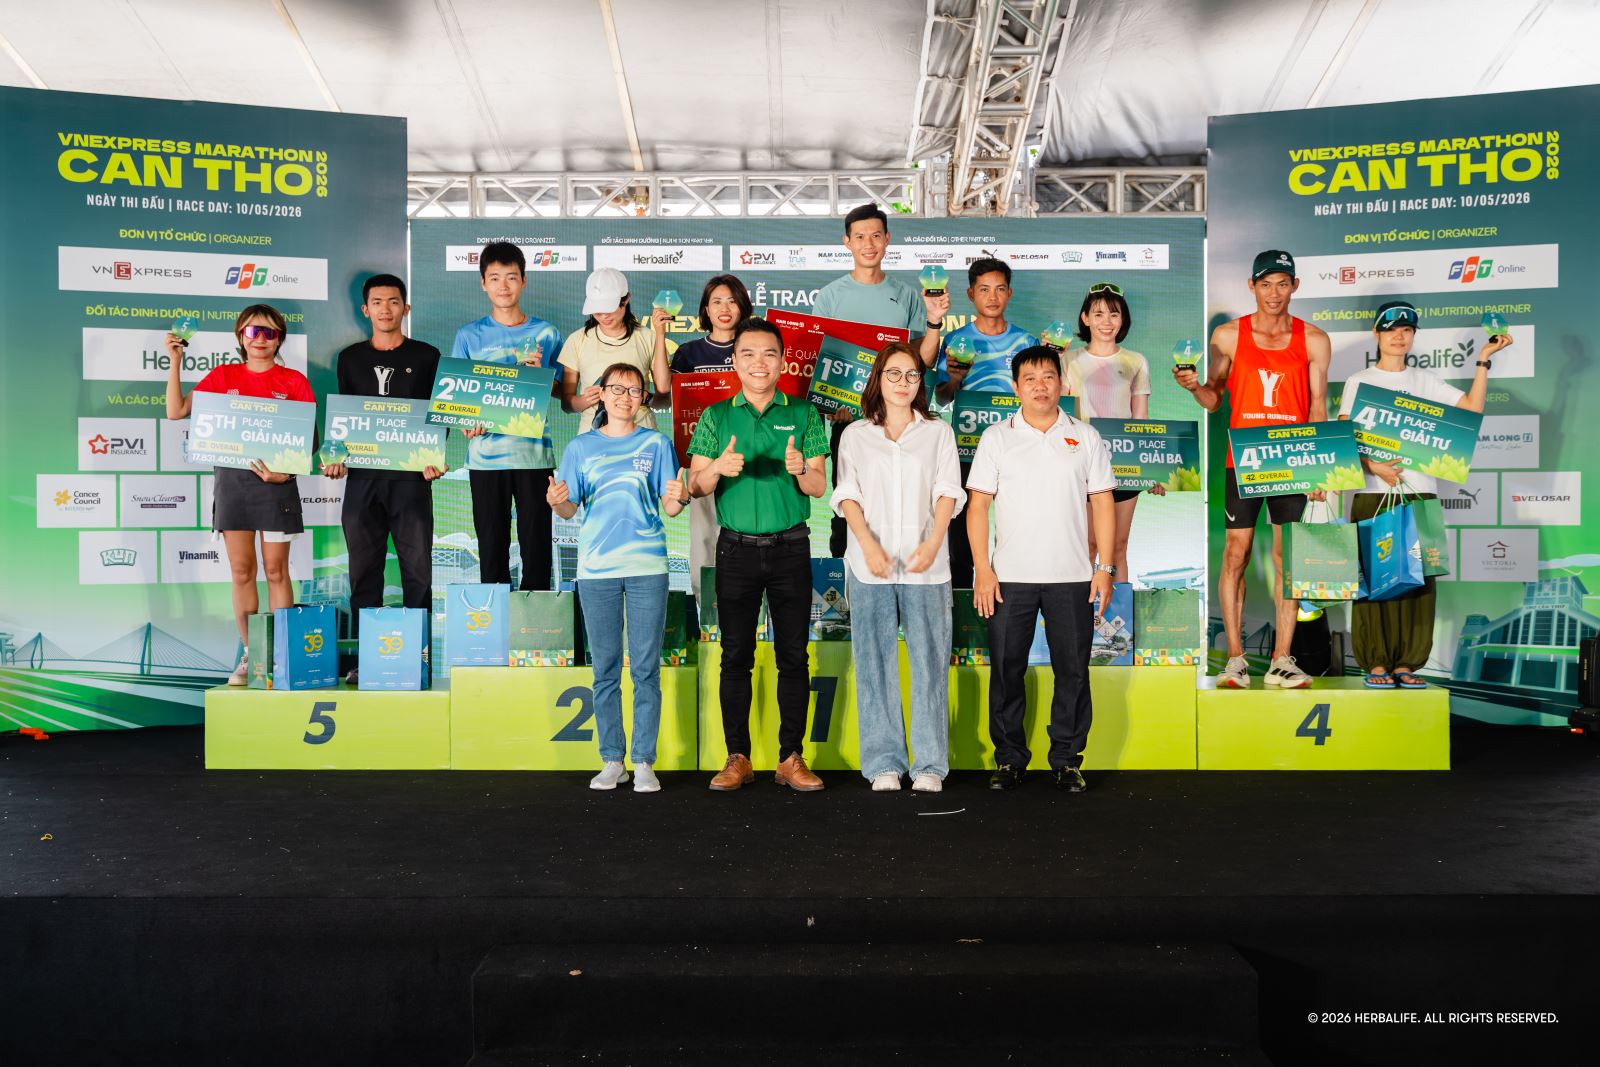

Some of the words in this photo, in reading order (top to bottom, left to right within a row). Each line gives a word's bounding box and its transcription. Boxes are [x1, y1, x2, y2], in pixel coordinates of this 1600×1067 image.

[57, 132, 191, 154] VNEXPRESS
[195, 142, 313, 162] MARATHON
[1289, 141, 1416, 162] VNEXPRESS
[1419, 132, 1543, 153] MARATHON
[1546, 131, 1559, 180] 2026
[57, 149, 182, 188] CAN
[193, 158, 313, 196] THO
[316, 150, 328, 198] 2026
[1288, 158, 1406, 196] CAN
[1417, 148, 1543, 187] THO
[86, 193, 117, 207] NGÀY
[120, 196, 138, 208] THI
[142, 195, 165, 209] ĐẤU
[176, 200, 205, 212] RACE
[208, 201, 233, 214] DAY:
[236, 203, 302, 217] 10/05/2026
[1314, 202, 1343, 216] NGÀY
[1346, 202, 1363, 214] THI
[1366, 198, 1389, 213] ĐẤU
[1400, 198, 1429, 211] RACE
[1431, 197, 1457, 209] DAY:
[1460, 192, 1531, 207] 10/05/2026
[119, 229, 144, 239] ĐƠN
[146, 230, 158, 241] VỊ
[159, 228, 174, 241] TỔ
[175, 230, 207, 242] CHỨC
[213, 233, 272, 245] ORGANIZER
[1344, 233, 1369, 244] ĐƠN
[1370, 233, 1381, 244] VỊ
[1383, 228, 1397, 242] TỔ
[1398, 229, 1430, 241] CHỨC
[1437, 227, 1498, 239] ORGANIZER
[633, 254, 680, 264] Herbalife
[754, 253, 775, 261] PVI
[1096, 251, 1127, 259] Vinamilk
[226, 266, 268, 286] FPT
[272, 274, 298, 284] Online
[1449, 259, 1493, 280] FPT
[1497, 264, 1526, 274] Online
[86, 304, 106, 316] ĐỐI
[108, 305, 129, 317] TÁC
[131, 308, 158, 318] DINH
[207, 310, 241, 321] NUTRIT
[1312, 309, 1332, 321] ĐỐI
[1333, 309, 1354, 320] TÁC
[1355, 310, 1376, 319] DIN
[1429, 305, 1483, 316] NUTRITION
[1484, 303, 1531, 314] PARTNER
[143, 350, 242, 371] Hebalif
[820, 357, 853, 381] 1ST
[856, 367, 872, 378] PLA
[472, 367, 494, 376] CAN
[495, 369, 516, 378] THO
[435, 377, 481, 401] 2ND
[485, 381, 515, 393] PLACE
[818, 384, 828, 393] 42
[831, 388, 860, 403] OVERALL
[108, 393, 122, 405] VÀ
[125, 394, 149, 406] CÁC
[229, 402, 252, 410] CAN
[253, 404, 275, 413] THO
[482, 392, 510, 406] GIẢI
[992, 398, 1013, 407] CAN
[1394, 398, 1417, 411] CAN
[1418, 405, 1442, 417] THO
[363, 403, 385, 412] CAN
[386, 404, 408, 413] THO
[436, 403, 446, 411] 42
[449, 405, 477, 414] OVERALL
[194, 413, 236, 438] 5TH
[242, 417, 273, 429] PLACE
[430, 414, 476, 427] 23.831.400
[958, 410, 1002, 434] 3RD
[1352, 405, 1402, 431] 4TH
[1403, 415, 1437, 432] PLACE
[330, 416, 371, 440] 5TH
[376, 418, 407, 428] PLACE
[1144, 426, 1164, 434] THO
[1267, 431, 1291, 439] CAN
[1292, 428, 1313, 437] THO
[110, 438, 144, 449] PVI
[241, 428, 270, 444] GIẢI
[272, 432, 305, 447] NĂM
[375, 429, 404, 443] GIẢI
[406, 431, 438, 445] NĂM
[1138, 440, 1166, 449] PLACE
[1366, 435, 1397, 449] OVERALL
[1400, 428, 1430, 446] GIẢI
[1431, 436, 1452, 451] TƯ
[1493, 434, 1521, 442] LONG
[371, 457, 391, 466] VND
[633, 459, 653, 468] CAN
[1139, 450, 1165, 464] GIẢI
[1166, 453, 1184, 464] BA
[1239, 444, 1282, 470] 4TH
[1284, 442, 1316, 453] PLACE
[1317, 452, 1336, 465] TƯ
[1245, 473, 1256, 481] 42
[1259, 472, 1289, 480] OVERALL
[73, 490, 99, 498] Cancer
[1243, 482, 1291, 494] 19.331.400
[1291, 481, 1311, 489] VND
[73, 497, 101, 505] Council
[178, 551, 219, 560] Vinamilk
[550, 686, 596, 742] 2
[810, 676, 839, 742] 1
[303, 701, 337, 745] 5
[1295, 703, 1332, 746] 4
